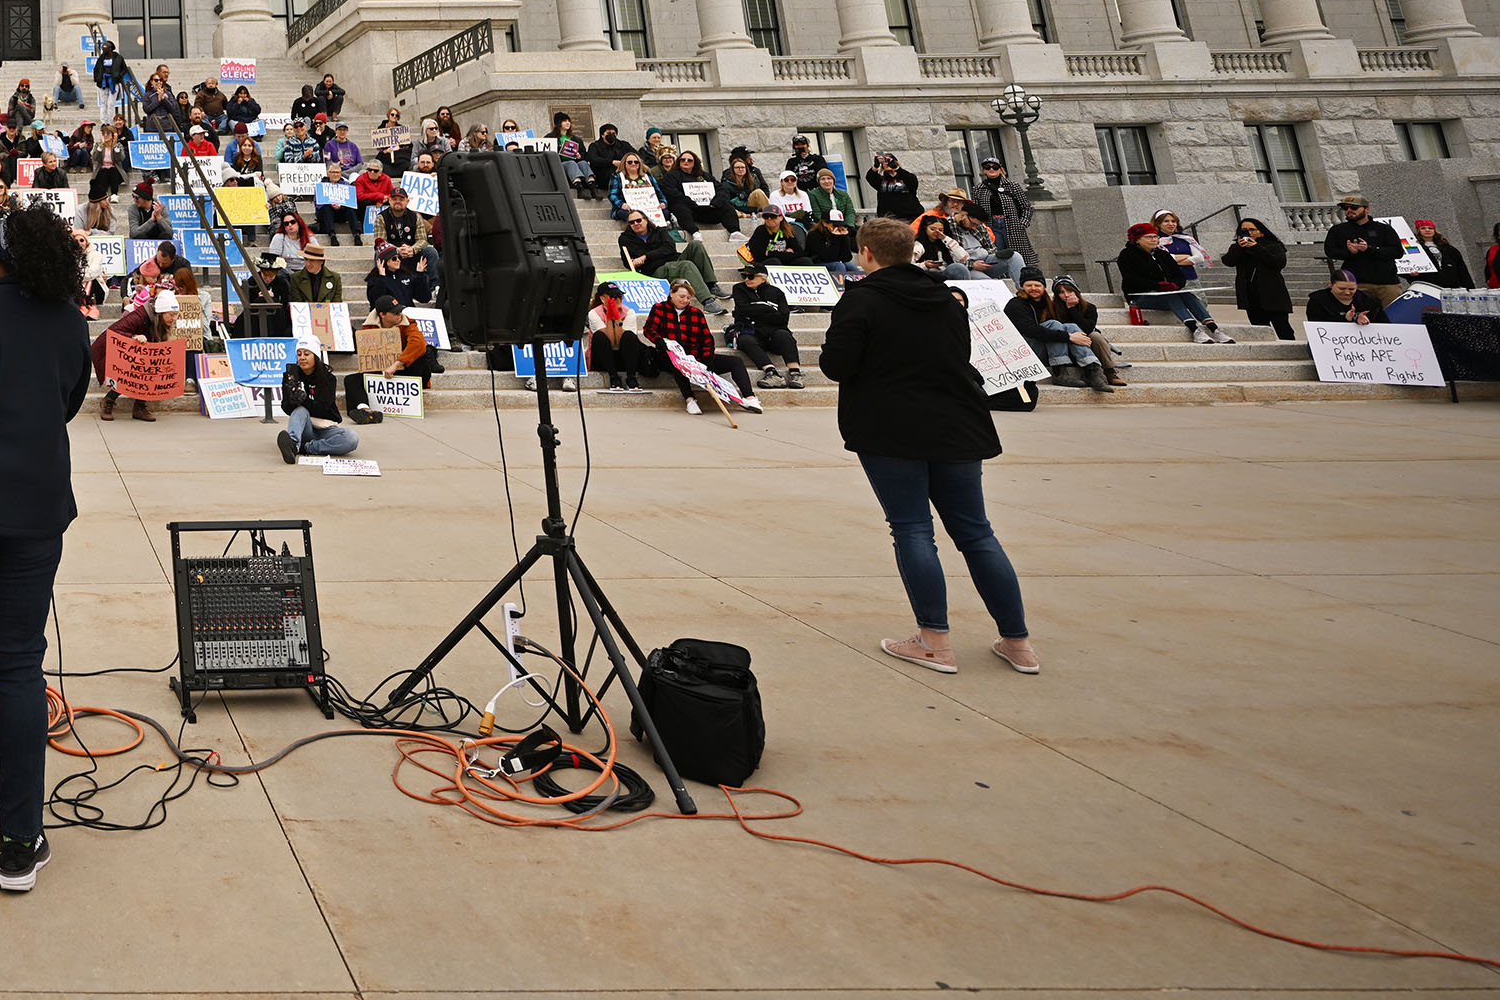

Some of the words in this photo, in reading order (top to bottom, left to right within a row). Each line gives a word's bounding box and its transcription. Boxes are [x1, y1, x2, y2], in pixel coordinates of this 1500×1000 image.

[221, 71, 256, 80] GLEICH
[389, 125, 409, 136] TRUTH
[372, 136, 400, 148] MATTER
[535, 142, 551, 151] I'M
[138, 143, 168, 154] HARRIS
[280, 173, 323, 184] FREEDOM
[402, 174, 438, 194] HARR
[784, 203, 804, 211] LET'S
[174, 211, 198, 219] WALZ
[533, 205, 566, 222] JBL
[617, 280, 641, 288] UTAH
[772, 272, 829, 286] HARRIS
[623, 286, 668, 302] HARRIS
[785, 285, 825, 295] WALZ
[183, 312, 201, 320] BODY
[176, 319, 201, 329] BRAIN
[315, 319, 329, 334] 4
[1317, 328, 1402, 351] Reproductive
[110, 336, 128, 350] THE
[127, 345, 172, 357] MASTER'S
[241, 342, 287, 361] HARRIS
[117, 350, 146, 366] TOOLS
[149, 358, 173, 366] WILL
[545, 357, 566, 367] ALZ
[1334, 349, 1366, 367] Rights
[1371, 349, 1397, 362] ARE
[130, 364, 162, 374] NEVER
[251, 361, 282, 371] WALZ
[112, 364, 156, 382] DISMANTLE
[160, 372, 178, 380] THE
[987, 363, 1043, 388] WOMEN
[1331, 365, 1373, 381] Human
[1385, 367, 1425, 384] Rights
[116, 377, 150, 391] MASTER'S
[367, 380, 420, 397] HARRIS
[211, 386, 241, 398] Against
[212, 394, 244, 405] Power
[376, 395, 410, 407] WALZ
[215, 402, 247, 413] Grabs
